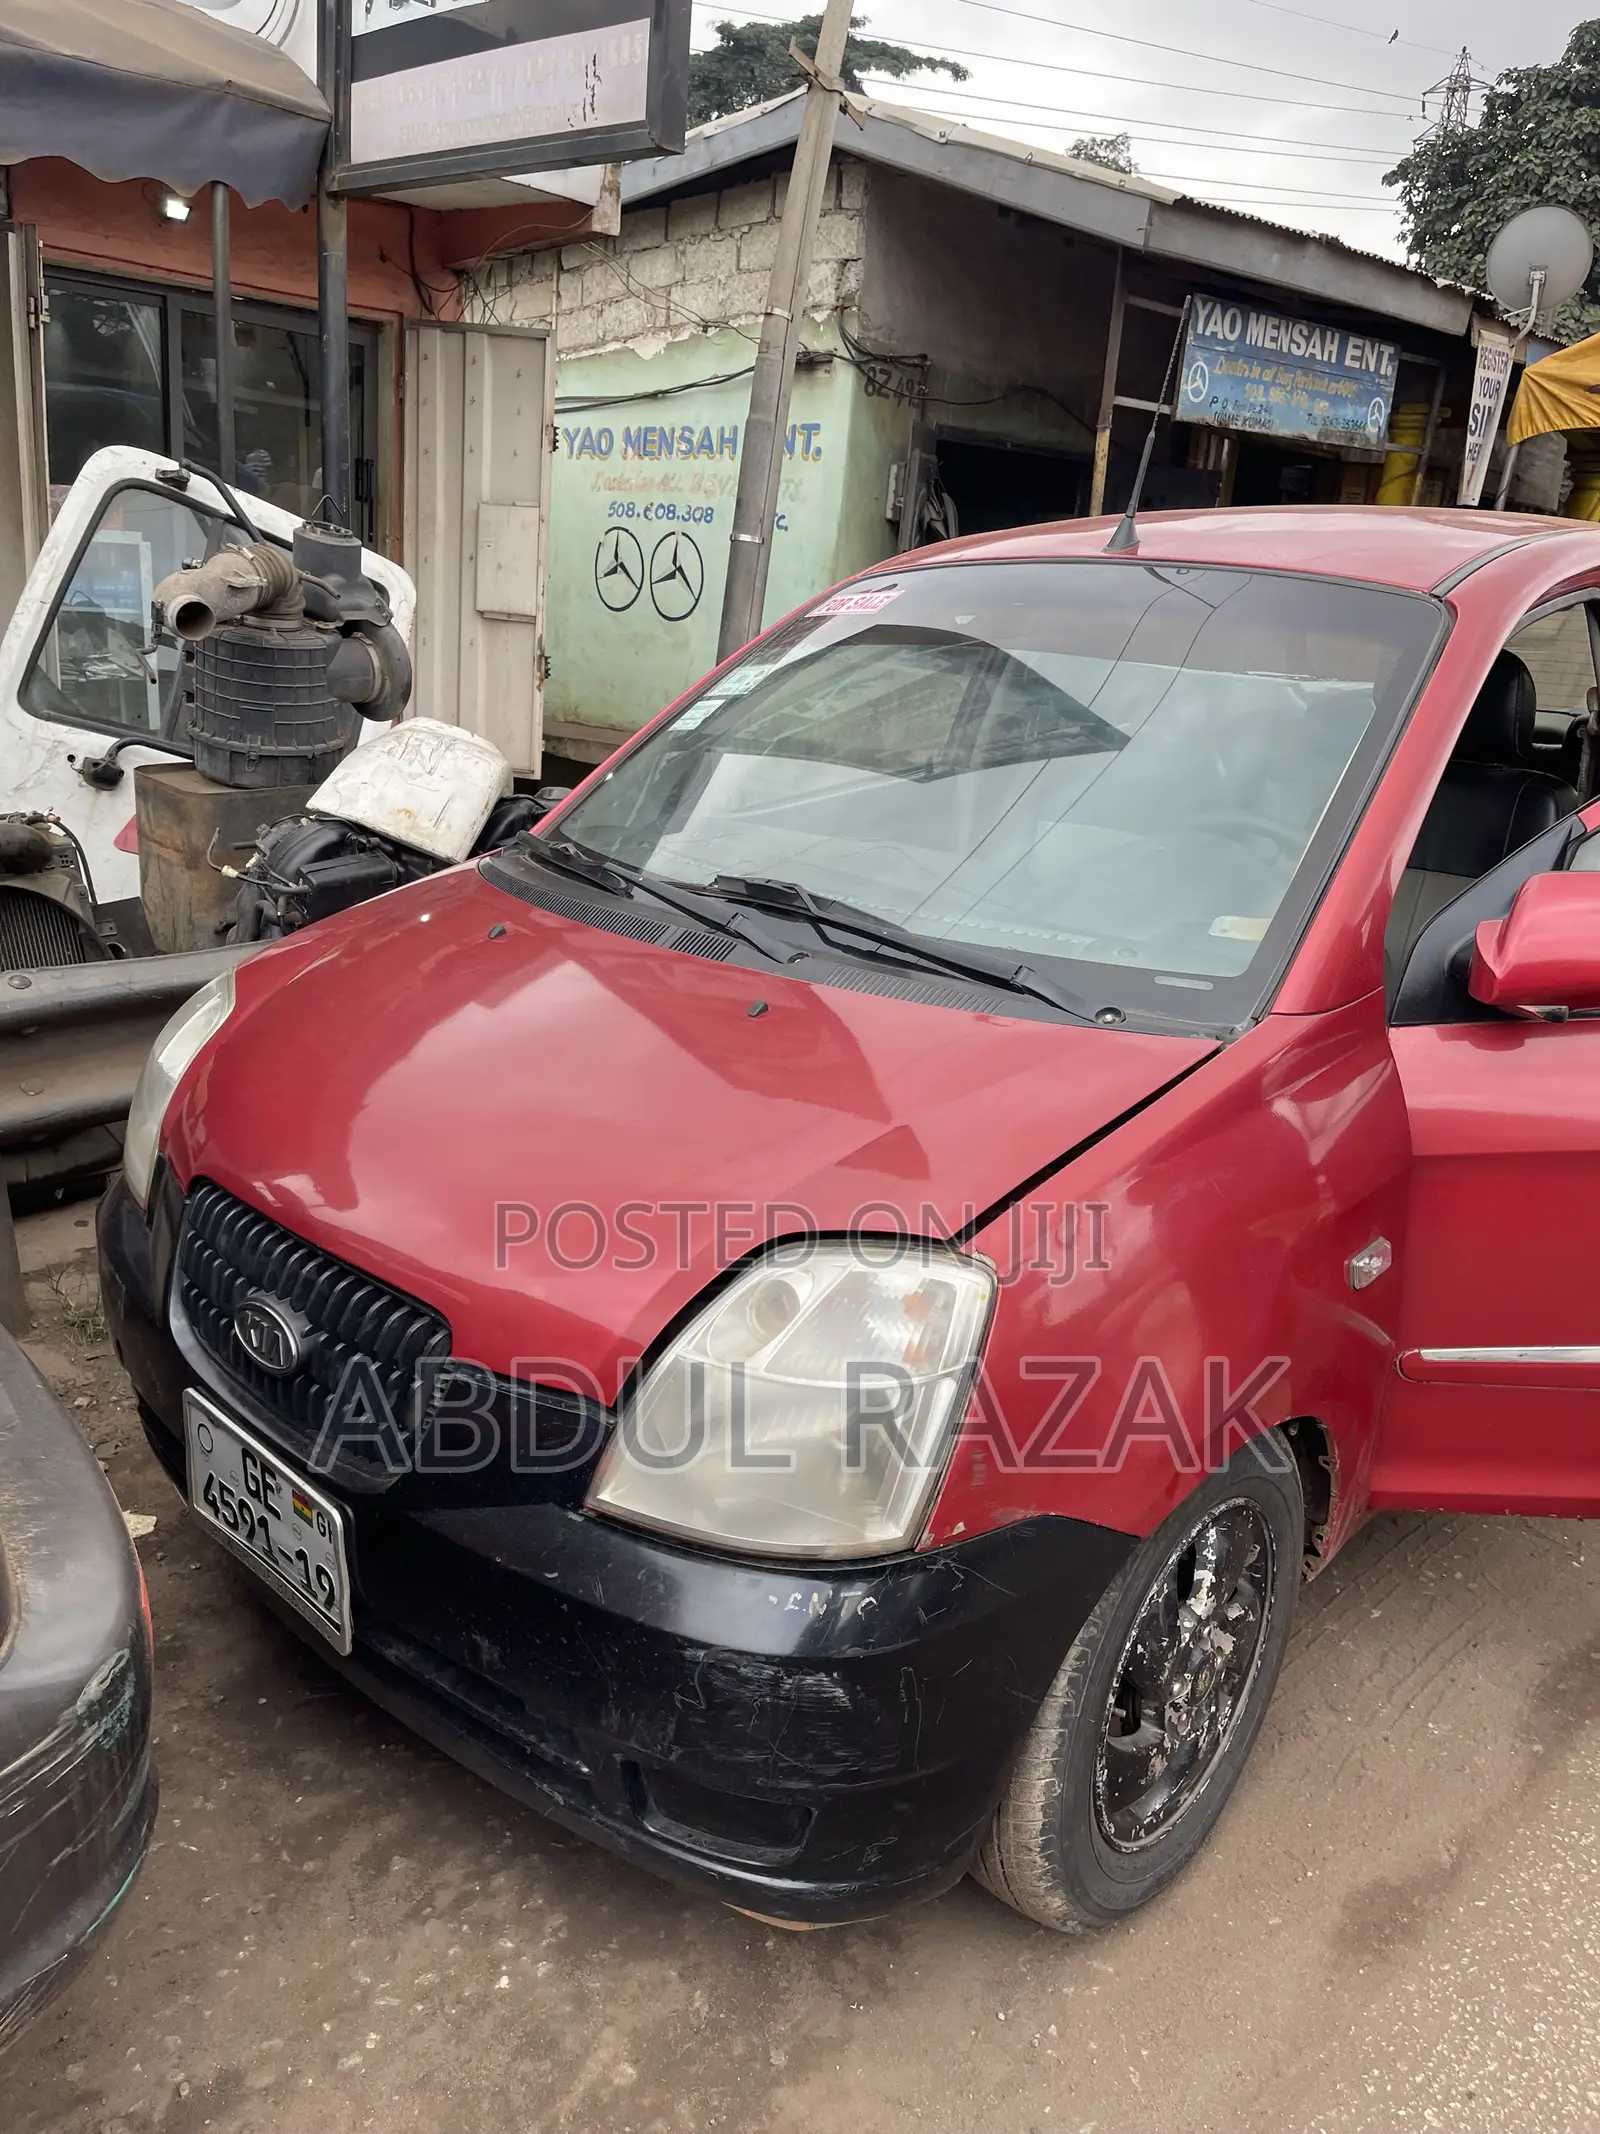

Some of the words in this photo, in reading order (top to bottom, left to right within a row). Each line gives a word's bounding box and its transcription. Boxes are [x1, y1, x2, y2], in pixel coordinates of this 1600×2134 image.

[1193, 299, 1242, 342] YAO
[1246, 311, 1340, 363] MENSAH
[1344, 336, 1395, 377] ENT.
[1479, 346, 1509, 374] REGISTER
[1479, 375, 1501, 401] YOUR
[563, 426, 615, 460] YAO
[620, 424, 739, 461] MENSAH
[783, 422, 823, 462] NT.
[845, 594, 893, 611] SALE
[241, 1447, 282, 1522] GE
[203, 1472, 335, 1612] 4591-19
